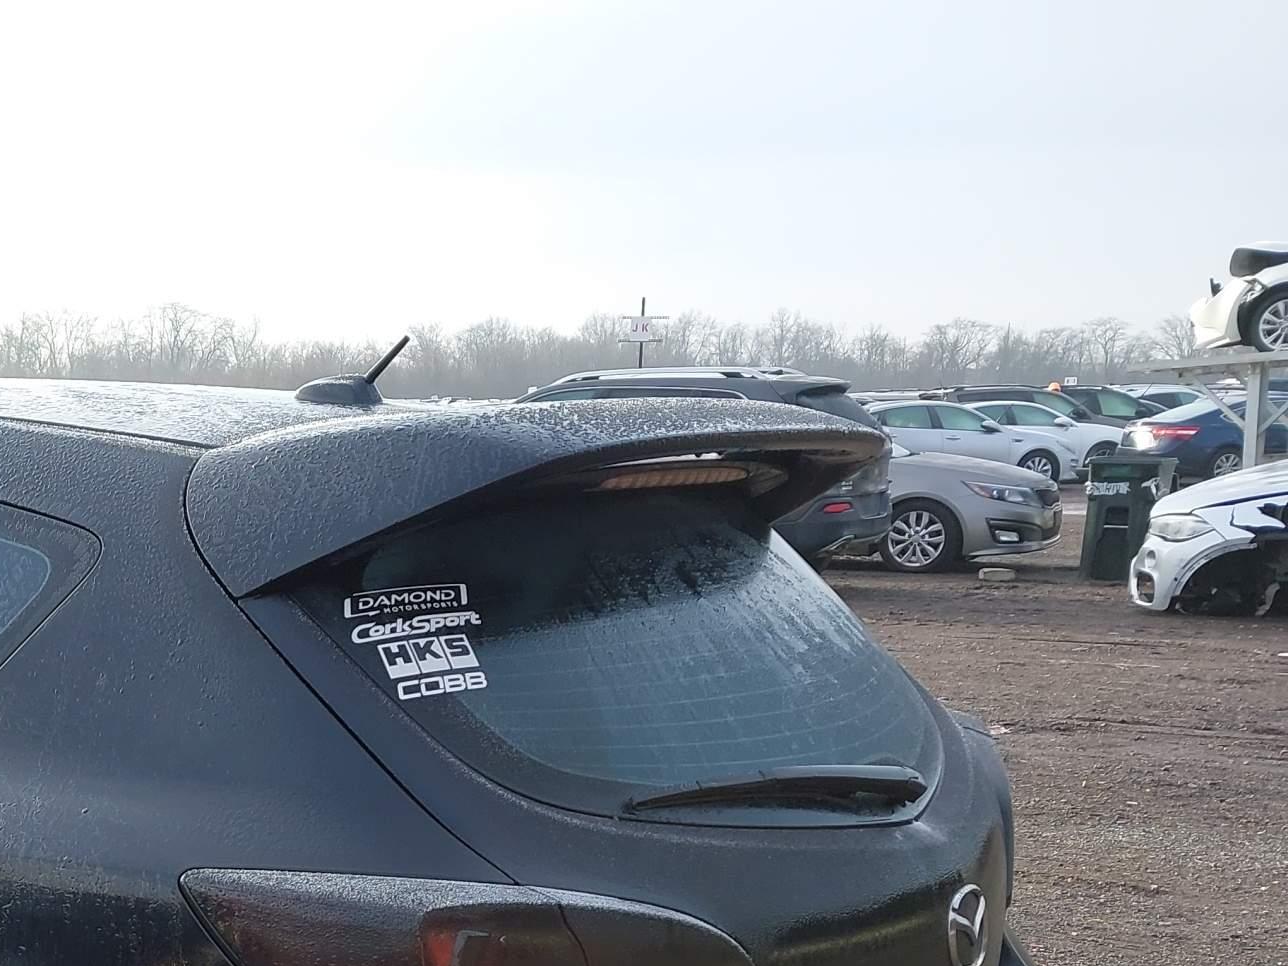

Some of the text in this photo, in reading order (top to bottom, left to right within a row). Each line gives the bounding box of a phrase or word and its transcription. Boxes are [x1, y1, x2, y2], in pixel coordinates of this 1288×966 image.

[358, 589, 456, 611] DAMOND
[383, 601, 459, 614] MOTORSPORTS
[351, 611, 482, 644] CorkSport
[379, 634, 476, 673] HKS
[397, 671, 488, 701] COBB
